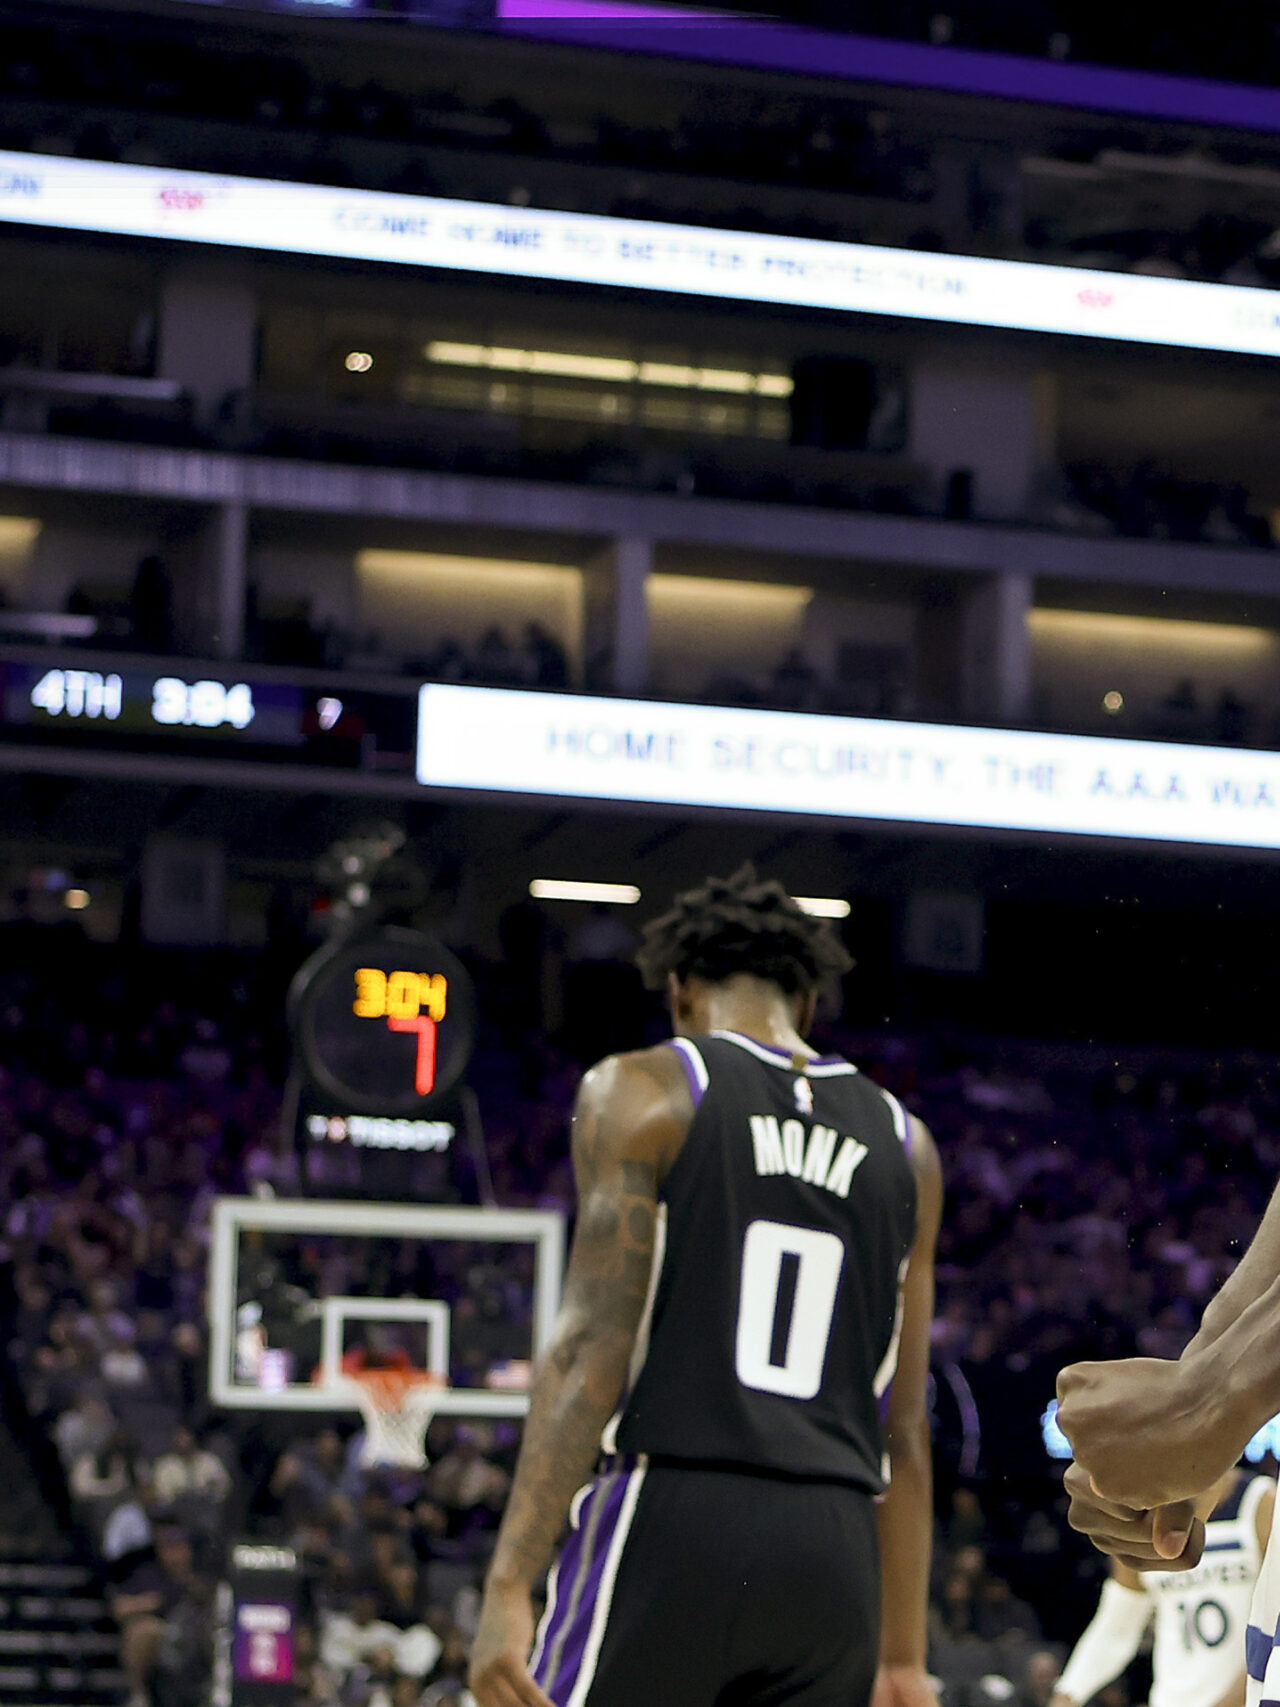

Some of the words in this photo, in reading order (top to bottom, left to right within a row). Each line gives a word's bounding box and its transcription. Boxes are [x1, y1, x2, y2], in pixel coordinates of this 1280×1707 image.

[31, 669, 123, 720] 4TH
[544, 720, 690, 774] HOME
[980, 752, 1068, 798] THE
[387, 1014, 438, 1096] 7
[750, 1114, 869, 1199] MONK
[735, 1217, 846, 1401] 0
[1176, 1597, 1231, 1654] 10
